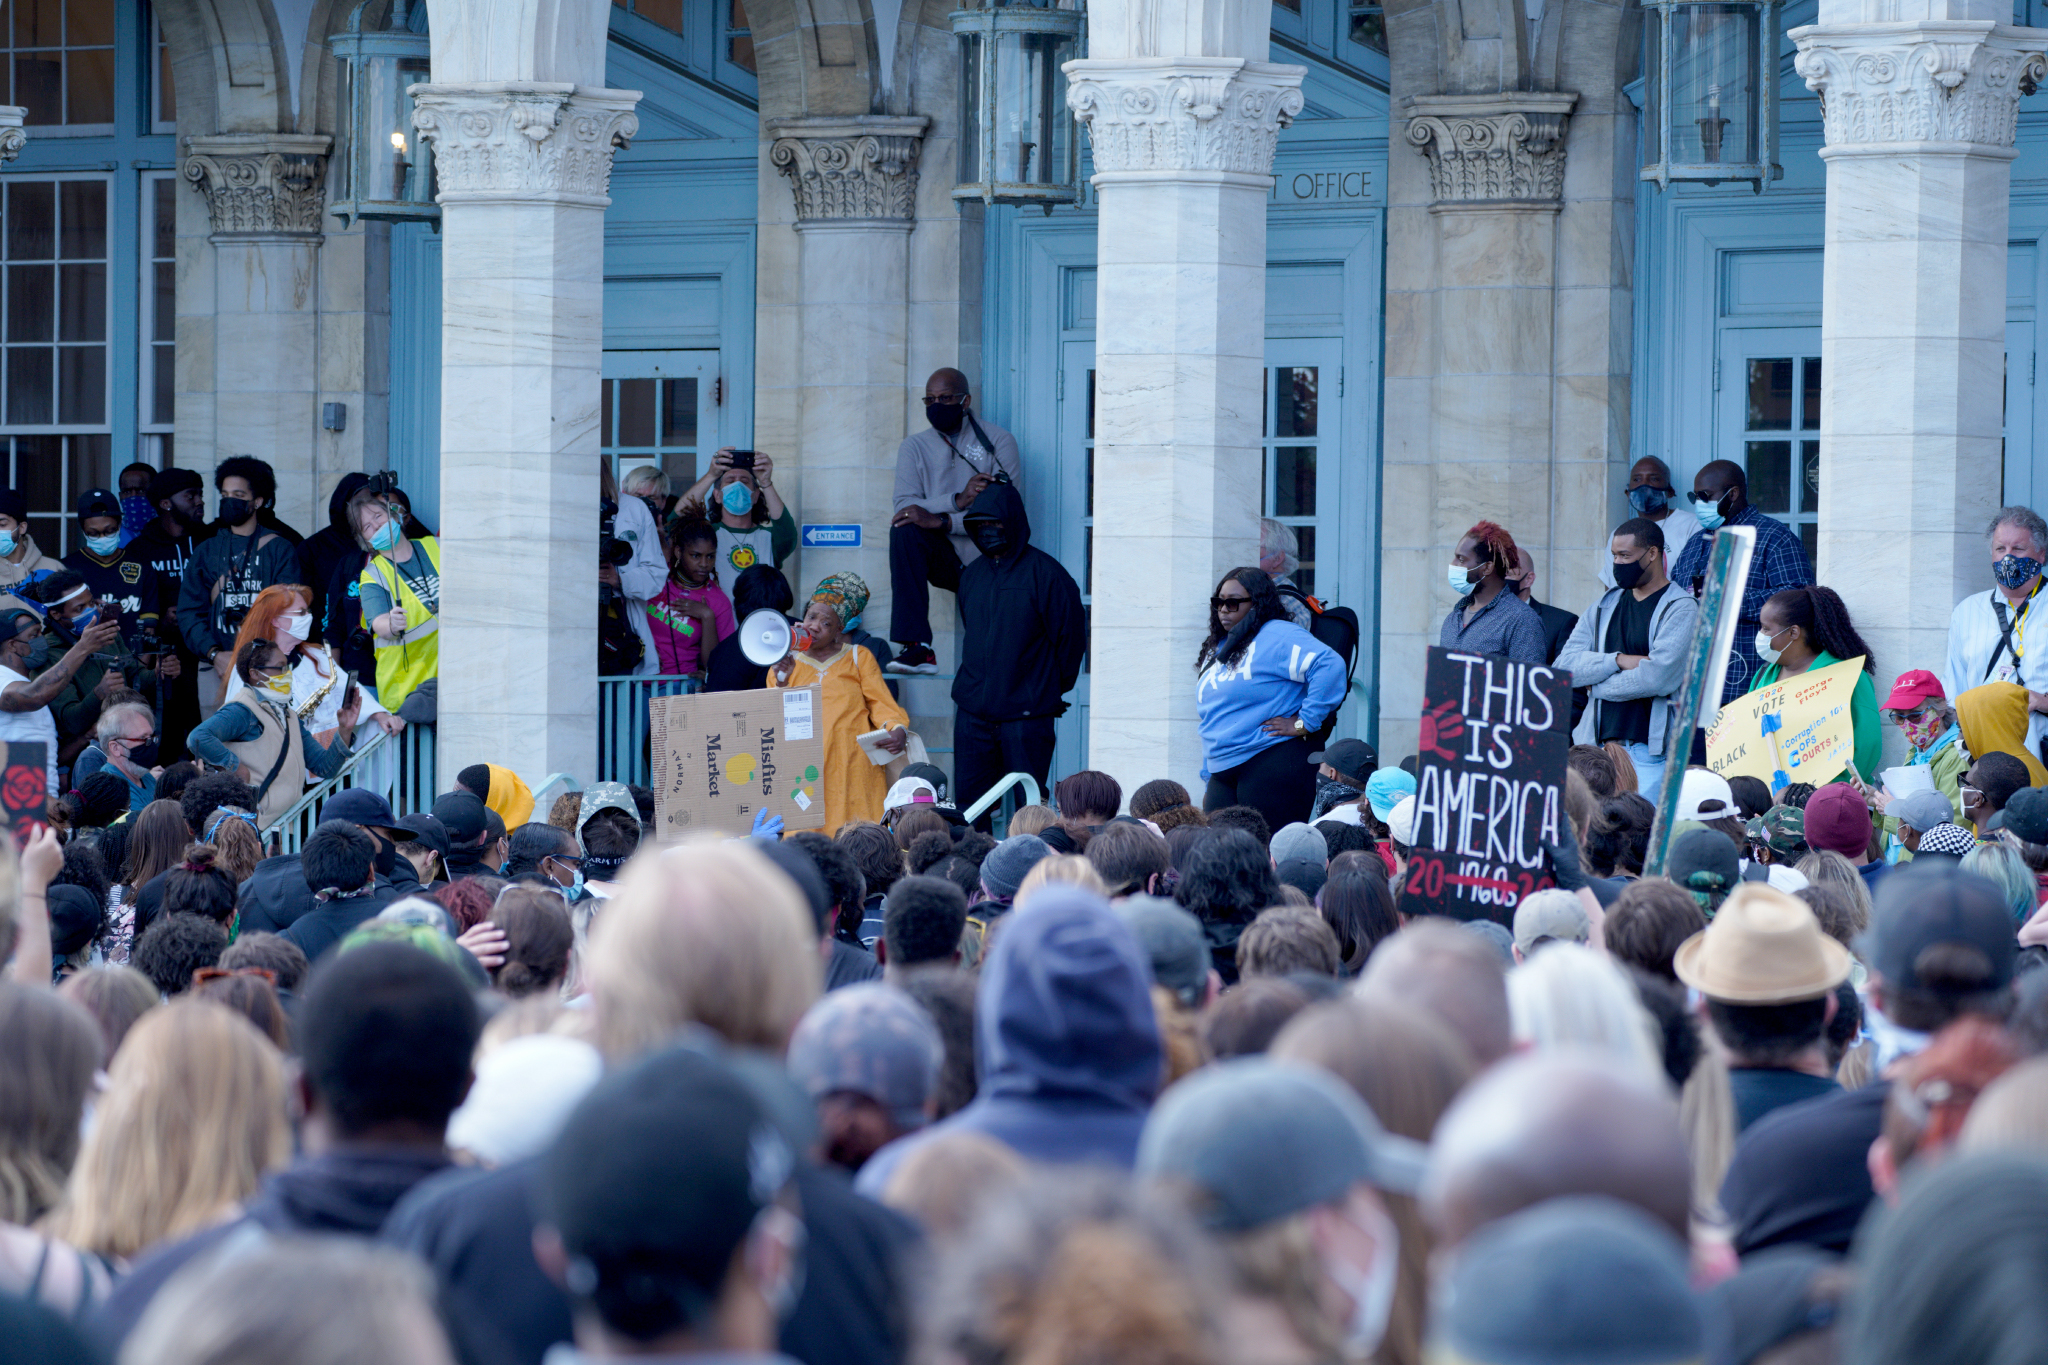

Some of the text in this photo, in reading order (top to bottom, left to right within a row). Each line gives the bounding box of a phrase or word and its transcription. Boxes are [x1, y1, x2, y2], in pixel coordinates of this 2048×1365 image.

[1293, 171, 1372, 199] OFFICE
[815, 532, 855, 540] ENTRANCE
[647, 603, 695, 638] MATTER
[1446, 653, 1554, 731] THIS
[1759, 686, 1783, 701] 2020
[1795, 677, 1833, 699] George
[1799, 685, 1827, 705] Floyd
[1753, 693, 1785, 720] VOTE
[760, 727, 776, 796] Misfits
[1464, 719, 1513, 769] IS
[1712, 743, 1747, 774] BLACK
[672, 750, 684, 794] NORMAL
[706, 734, 722, 798] Market
[1410, 765, 1559, 870] AMERICA
[1406, 856, 1445, 898] 20
